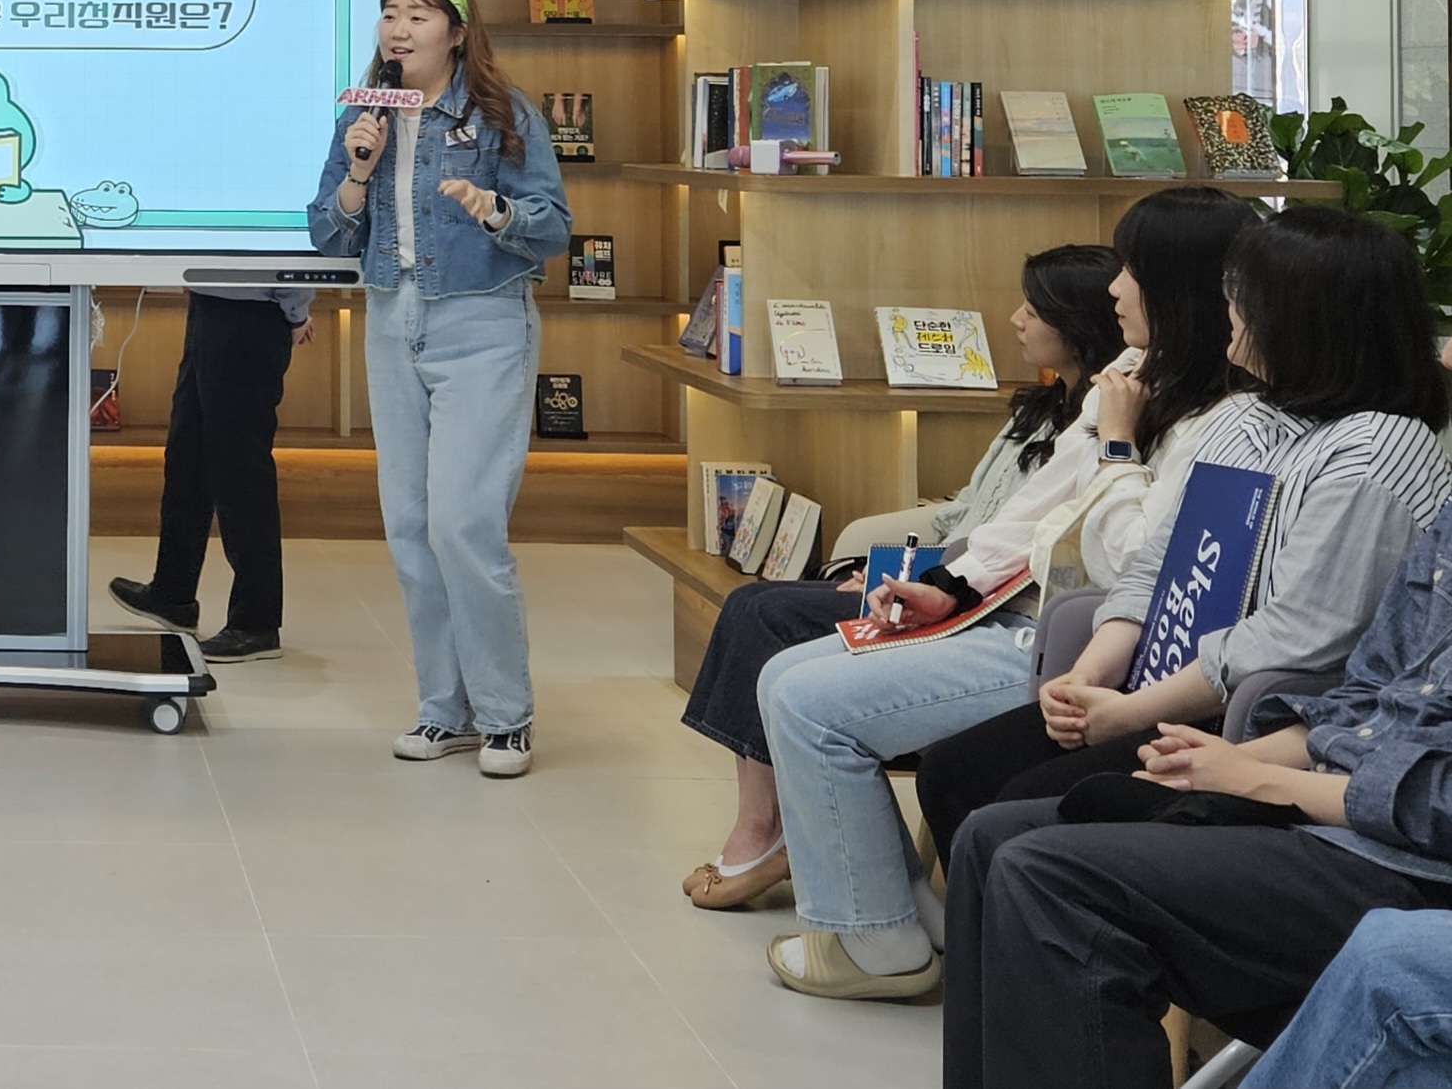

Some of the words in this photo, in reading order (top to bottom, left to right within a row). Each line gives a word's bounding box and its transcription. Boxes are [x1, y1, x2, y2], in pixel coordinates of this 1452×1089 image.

[9, 0, 233, 30] 우리청직원은?
[337, 89, 422, 106] ARMING
[571, 271, 612, 279] FUTURE
[914, 320, 952, 332] 단순한
[918, 343, 957, 354] 드로잉
[1159, 528, 1222, 681] Sketc
